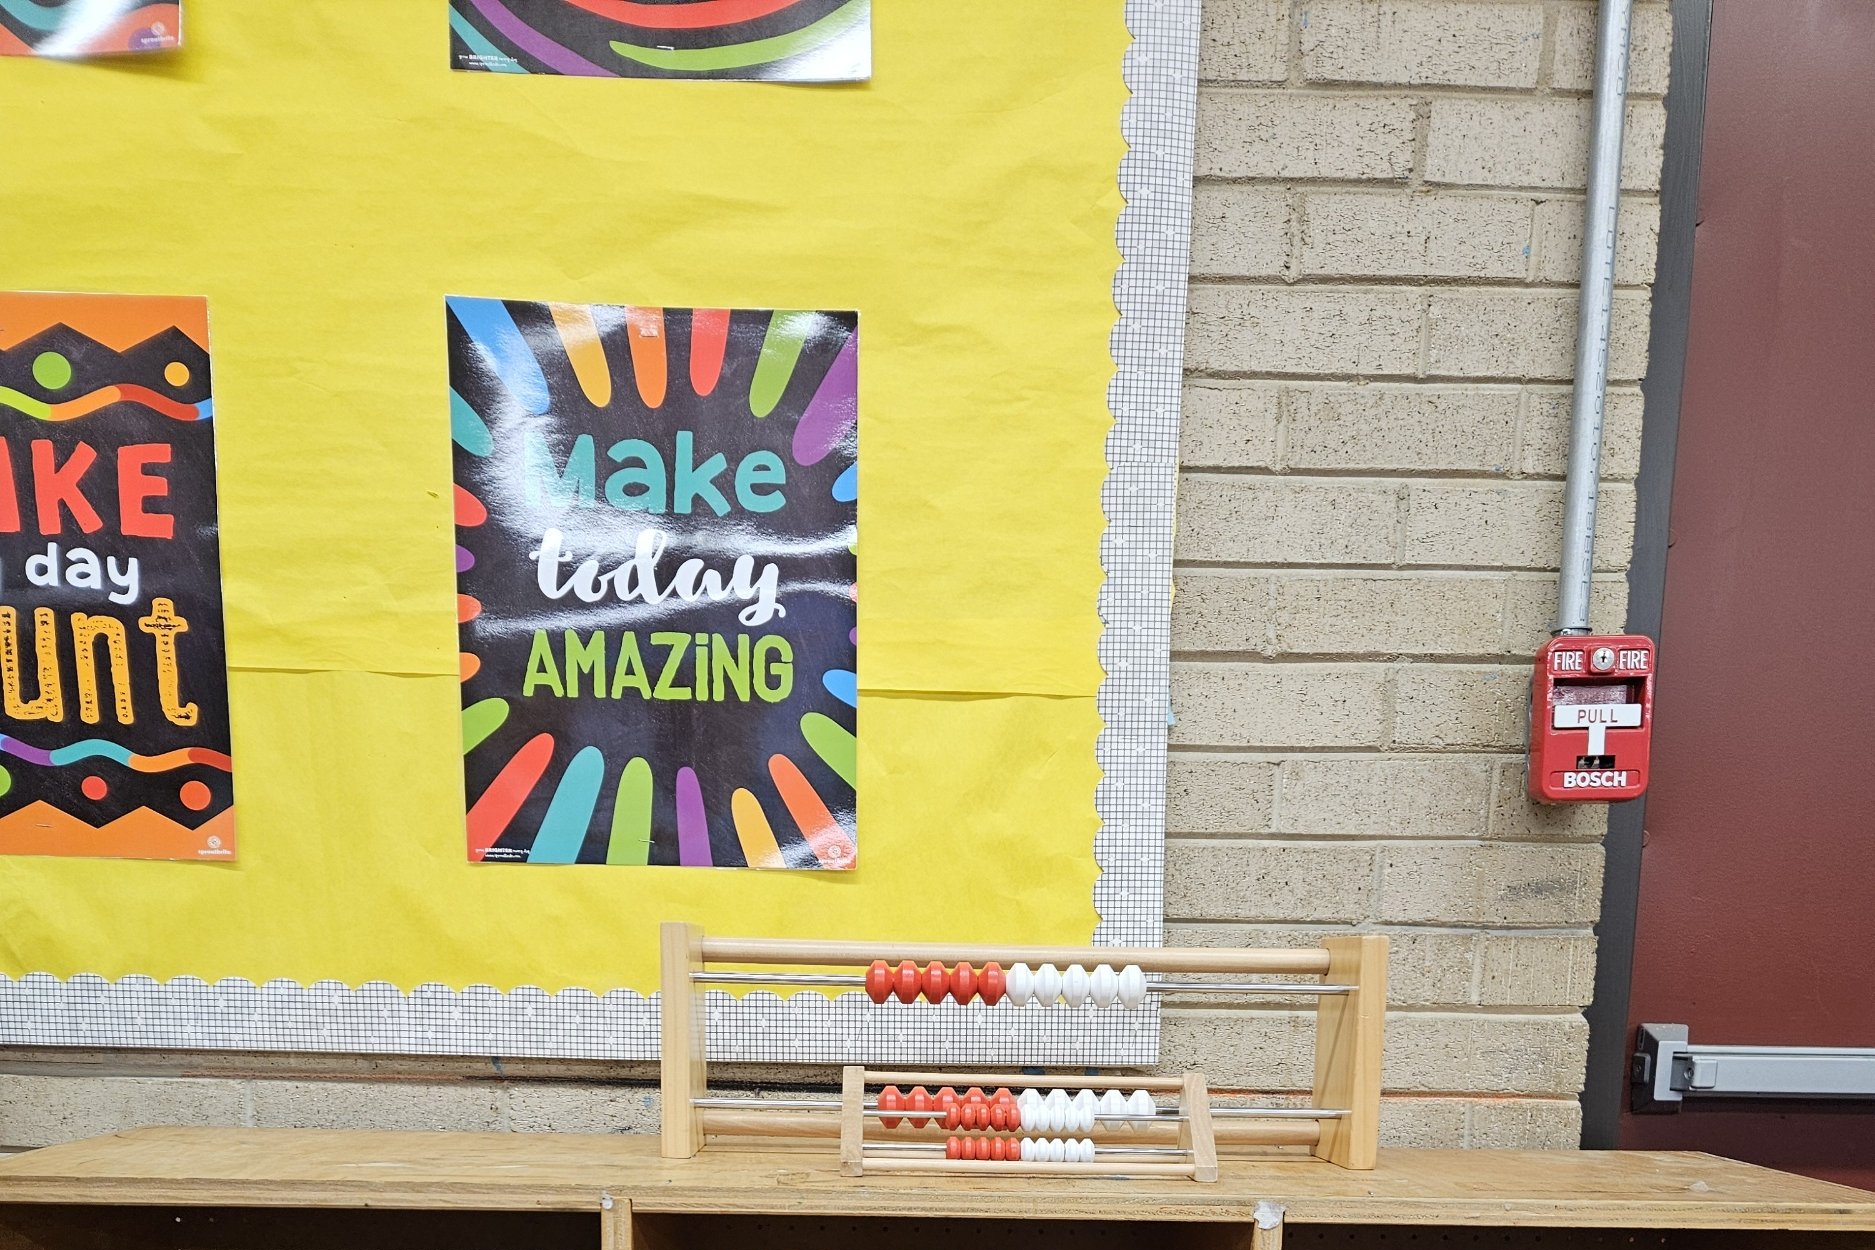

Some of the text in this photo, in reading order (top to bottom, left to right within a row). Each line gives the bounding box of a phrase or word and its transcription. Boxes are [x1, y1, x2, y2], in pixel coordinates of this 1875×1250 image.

[0, 437, 174, 539] KE
[524, 430, 787, 517] Make
[25, 542, 140, 605] day
[529, 527, 786, 627] today
[0, 597, 198, 727] unt
[1553, 650, 1649, 671] FIRE FIRE
[1577, 708, 1618, 724] PULL
[1563, 771, 1627, 788] BOSCH
